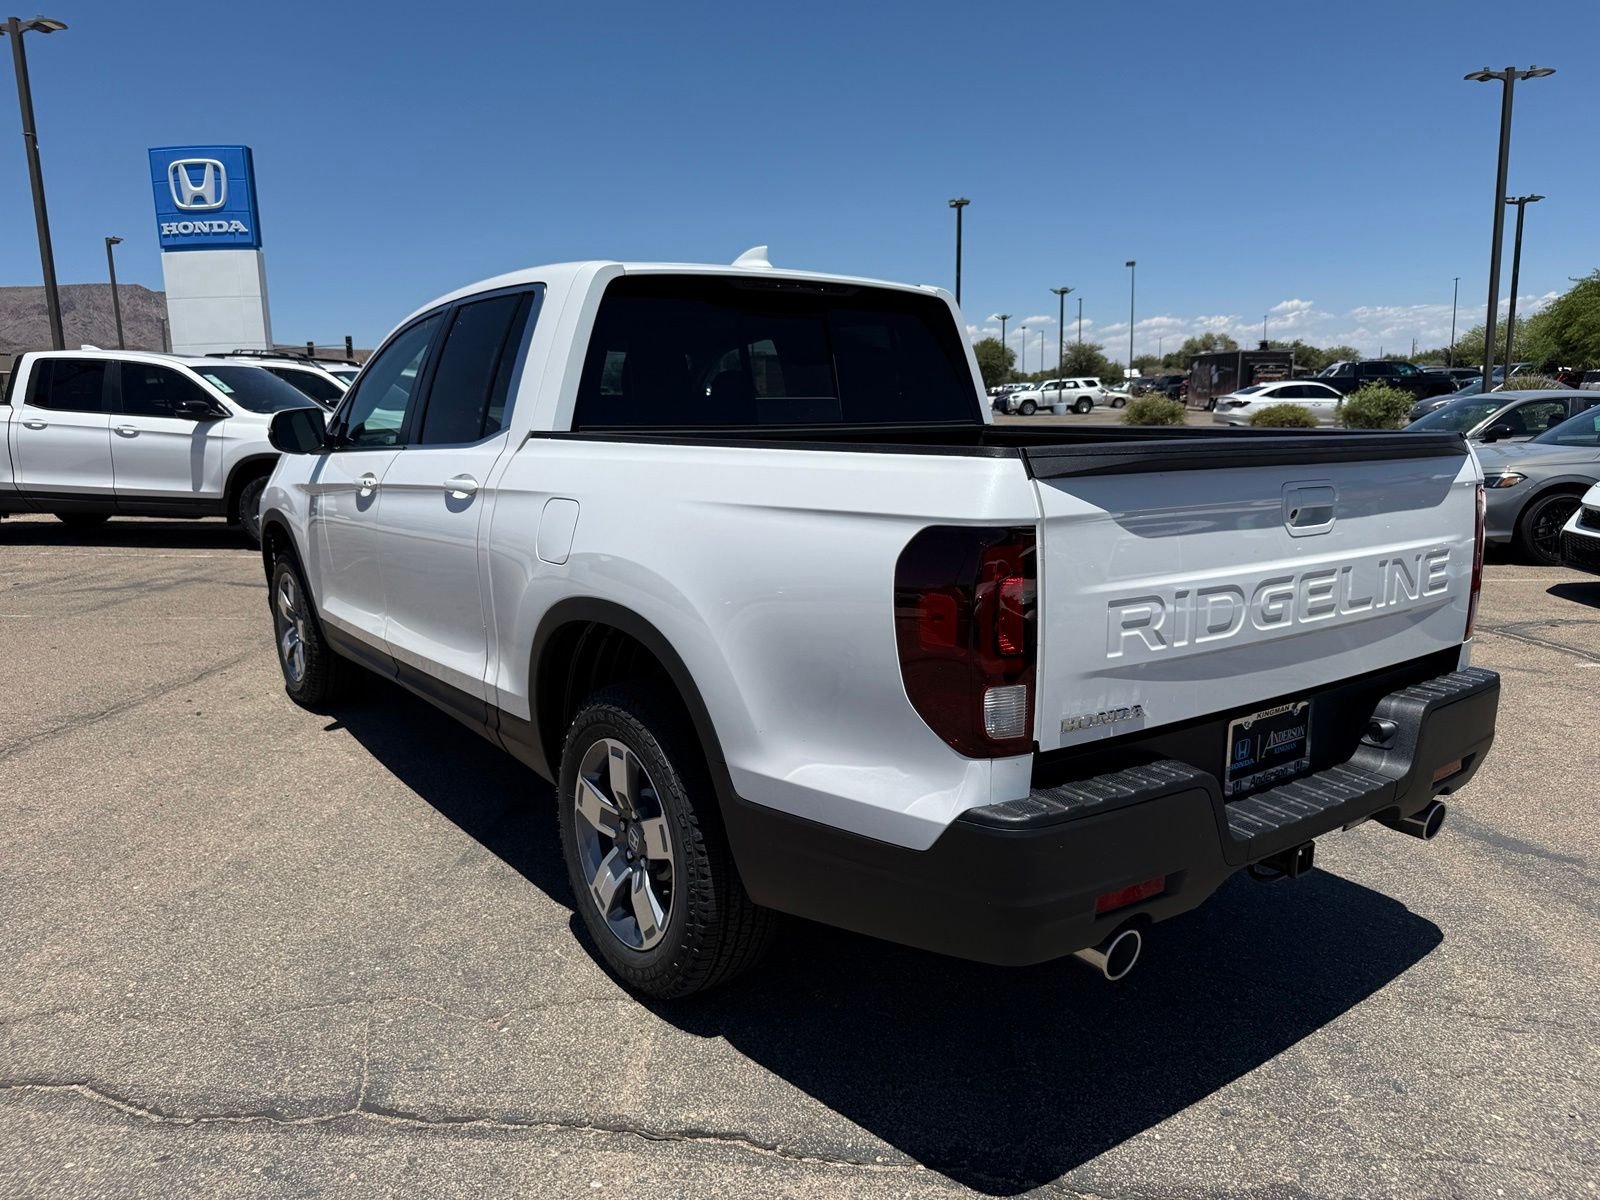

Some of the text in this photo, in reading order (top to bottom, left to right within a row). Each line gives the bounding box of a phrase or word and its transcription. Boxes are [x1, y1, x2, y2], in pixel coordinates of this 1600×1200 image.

[160, 220, 249, 235] HONDA
[1107, 548, 1451, 658] RIDGELINE
[1061, 705, 1145, 734] HONDA
[1257, 705, 1290, 720] KINGMAN
[1263, 724, 1305, 751] ANDERSON
